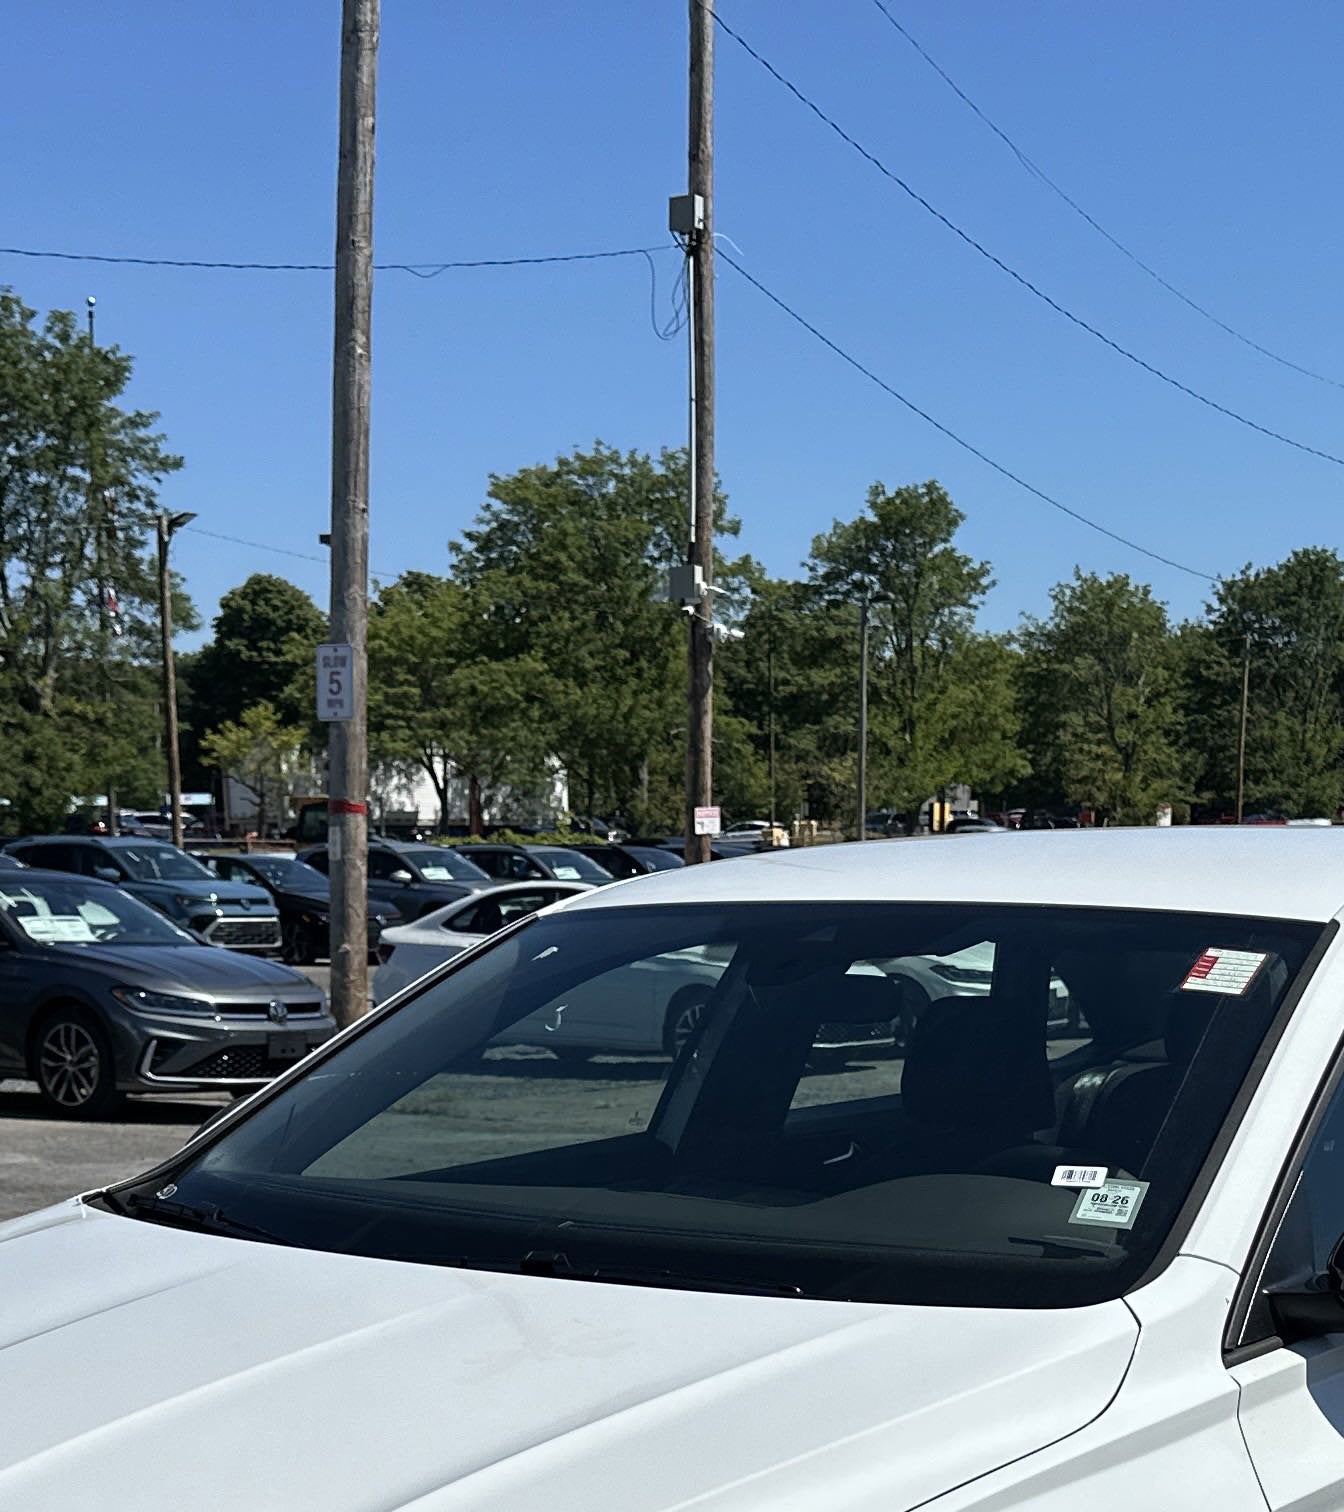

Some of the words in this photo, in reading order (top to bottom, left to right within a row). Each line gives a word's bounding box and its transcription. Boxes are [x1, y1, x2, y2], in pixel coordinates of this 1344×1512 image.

[328, 671, 342, 695] 5
[1091, 1192, 1109, 1203] 08
[1111, 1194, 1130, 1205] 26
